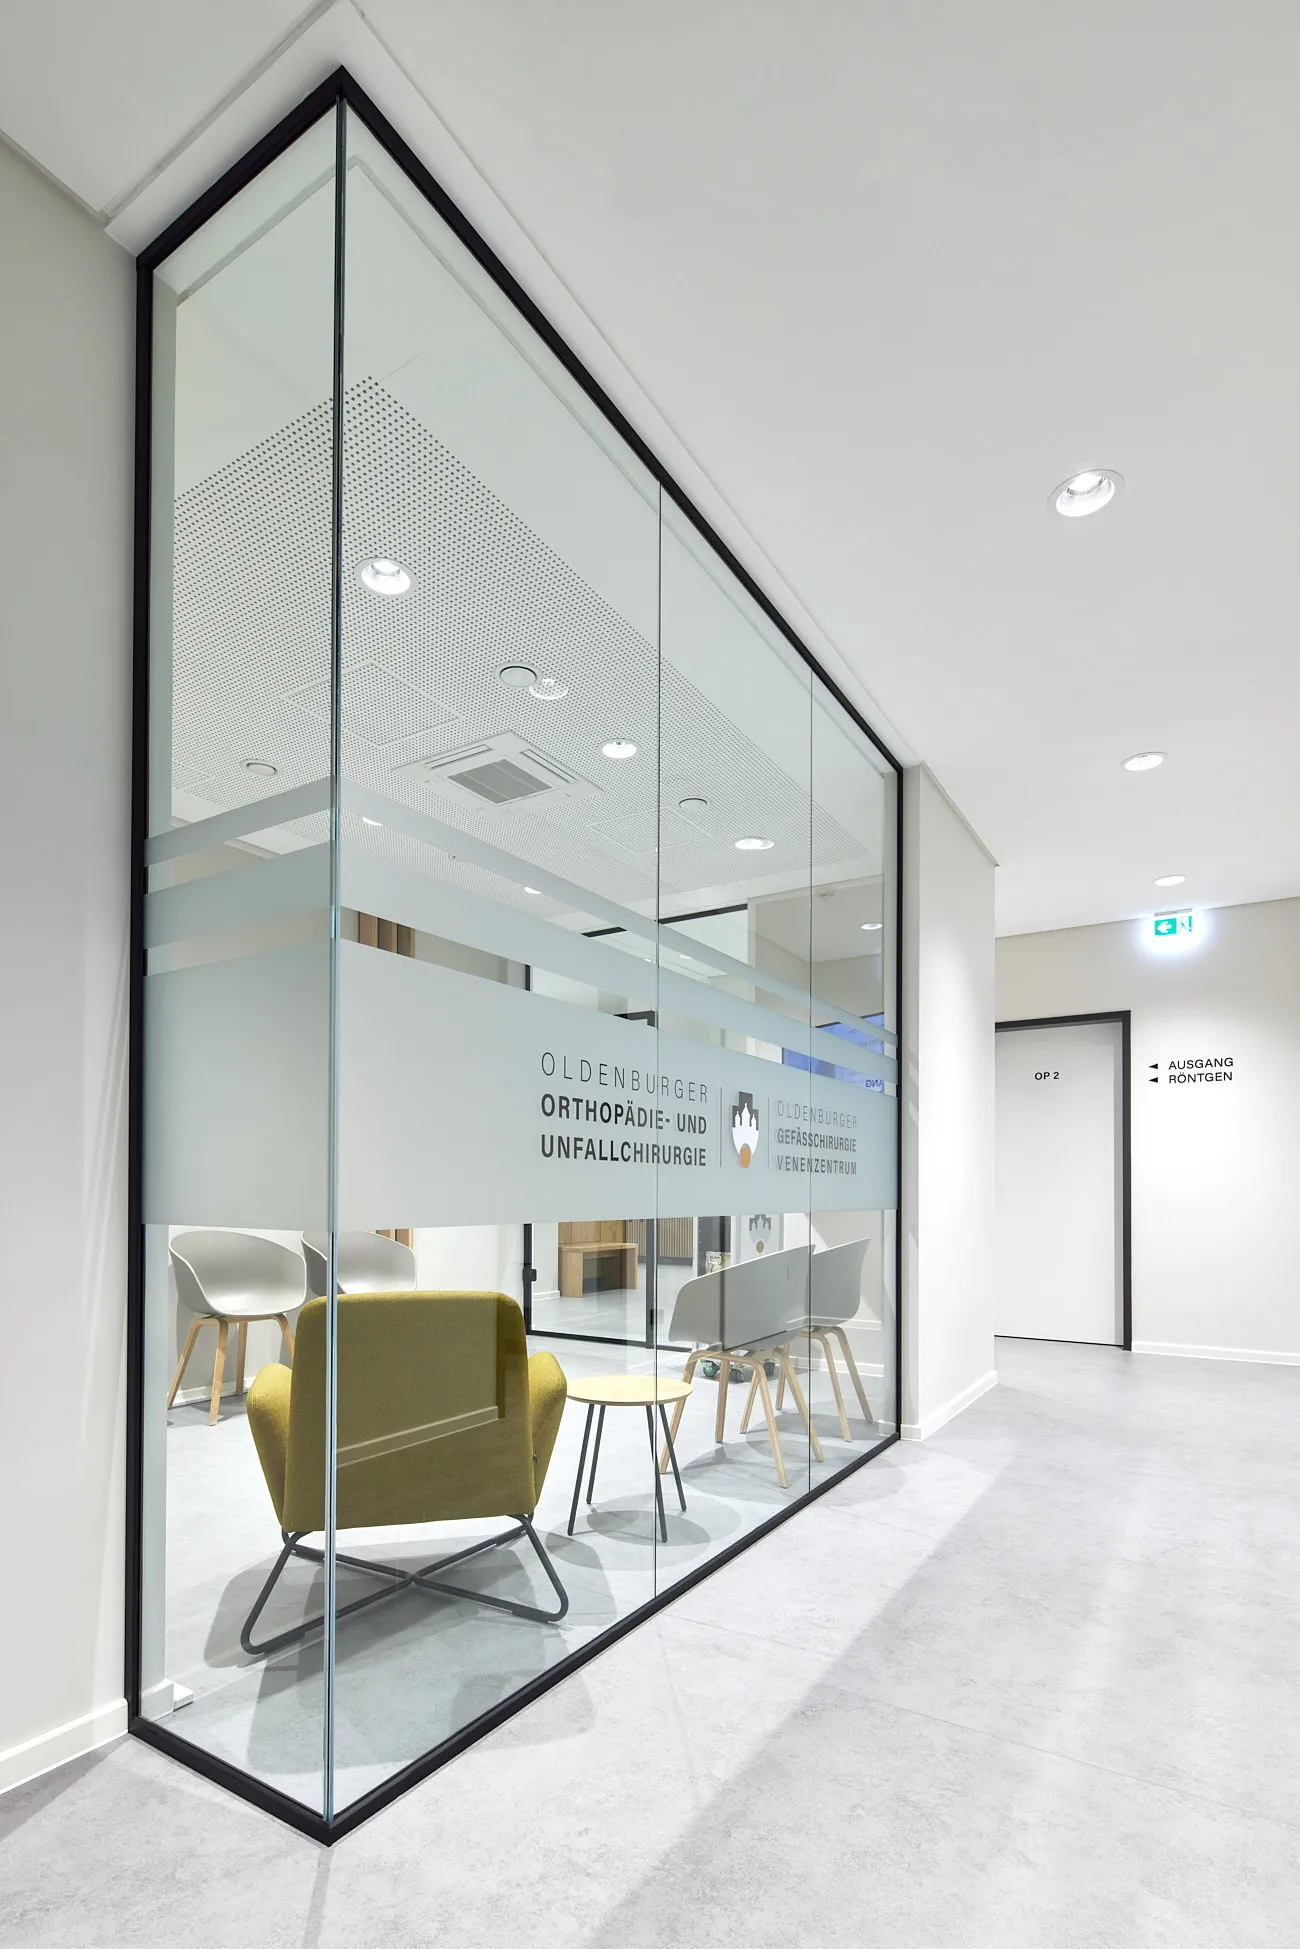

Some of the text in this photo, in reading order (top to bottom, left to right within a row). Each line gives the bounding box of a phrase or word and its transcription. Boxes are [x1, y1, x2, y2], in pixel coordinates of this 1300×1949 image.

[1034, 1071, 1060, 1081] OP 2
[1168, 1057, 1234, 1070] AUSGANG
[541, 1052, 708, 1103] OLDENBURGER
[1168, 1071, 1233, 1084] RÖNTGEN
[541, 1093, 707, 1135] ORTHOPÄDIE- UND
[777, 1100, 857, 1129] OLDENBURGER
[541, 1134, 707, 1167] UNFALLCHIRURGIE
[777, 1126, 857, 1152] GEFÄSSCHIRURGIE
[777, 1154, 857, 1175] VENENZENTRUM
